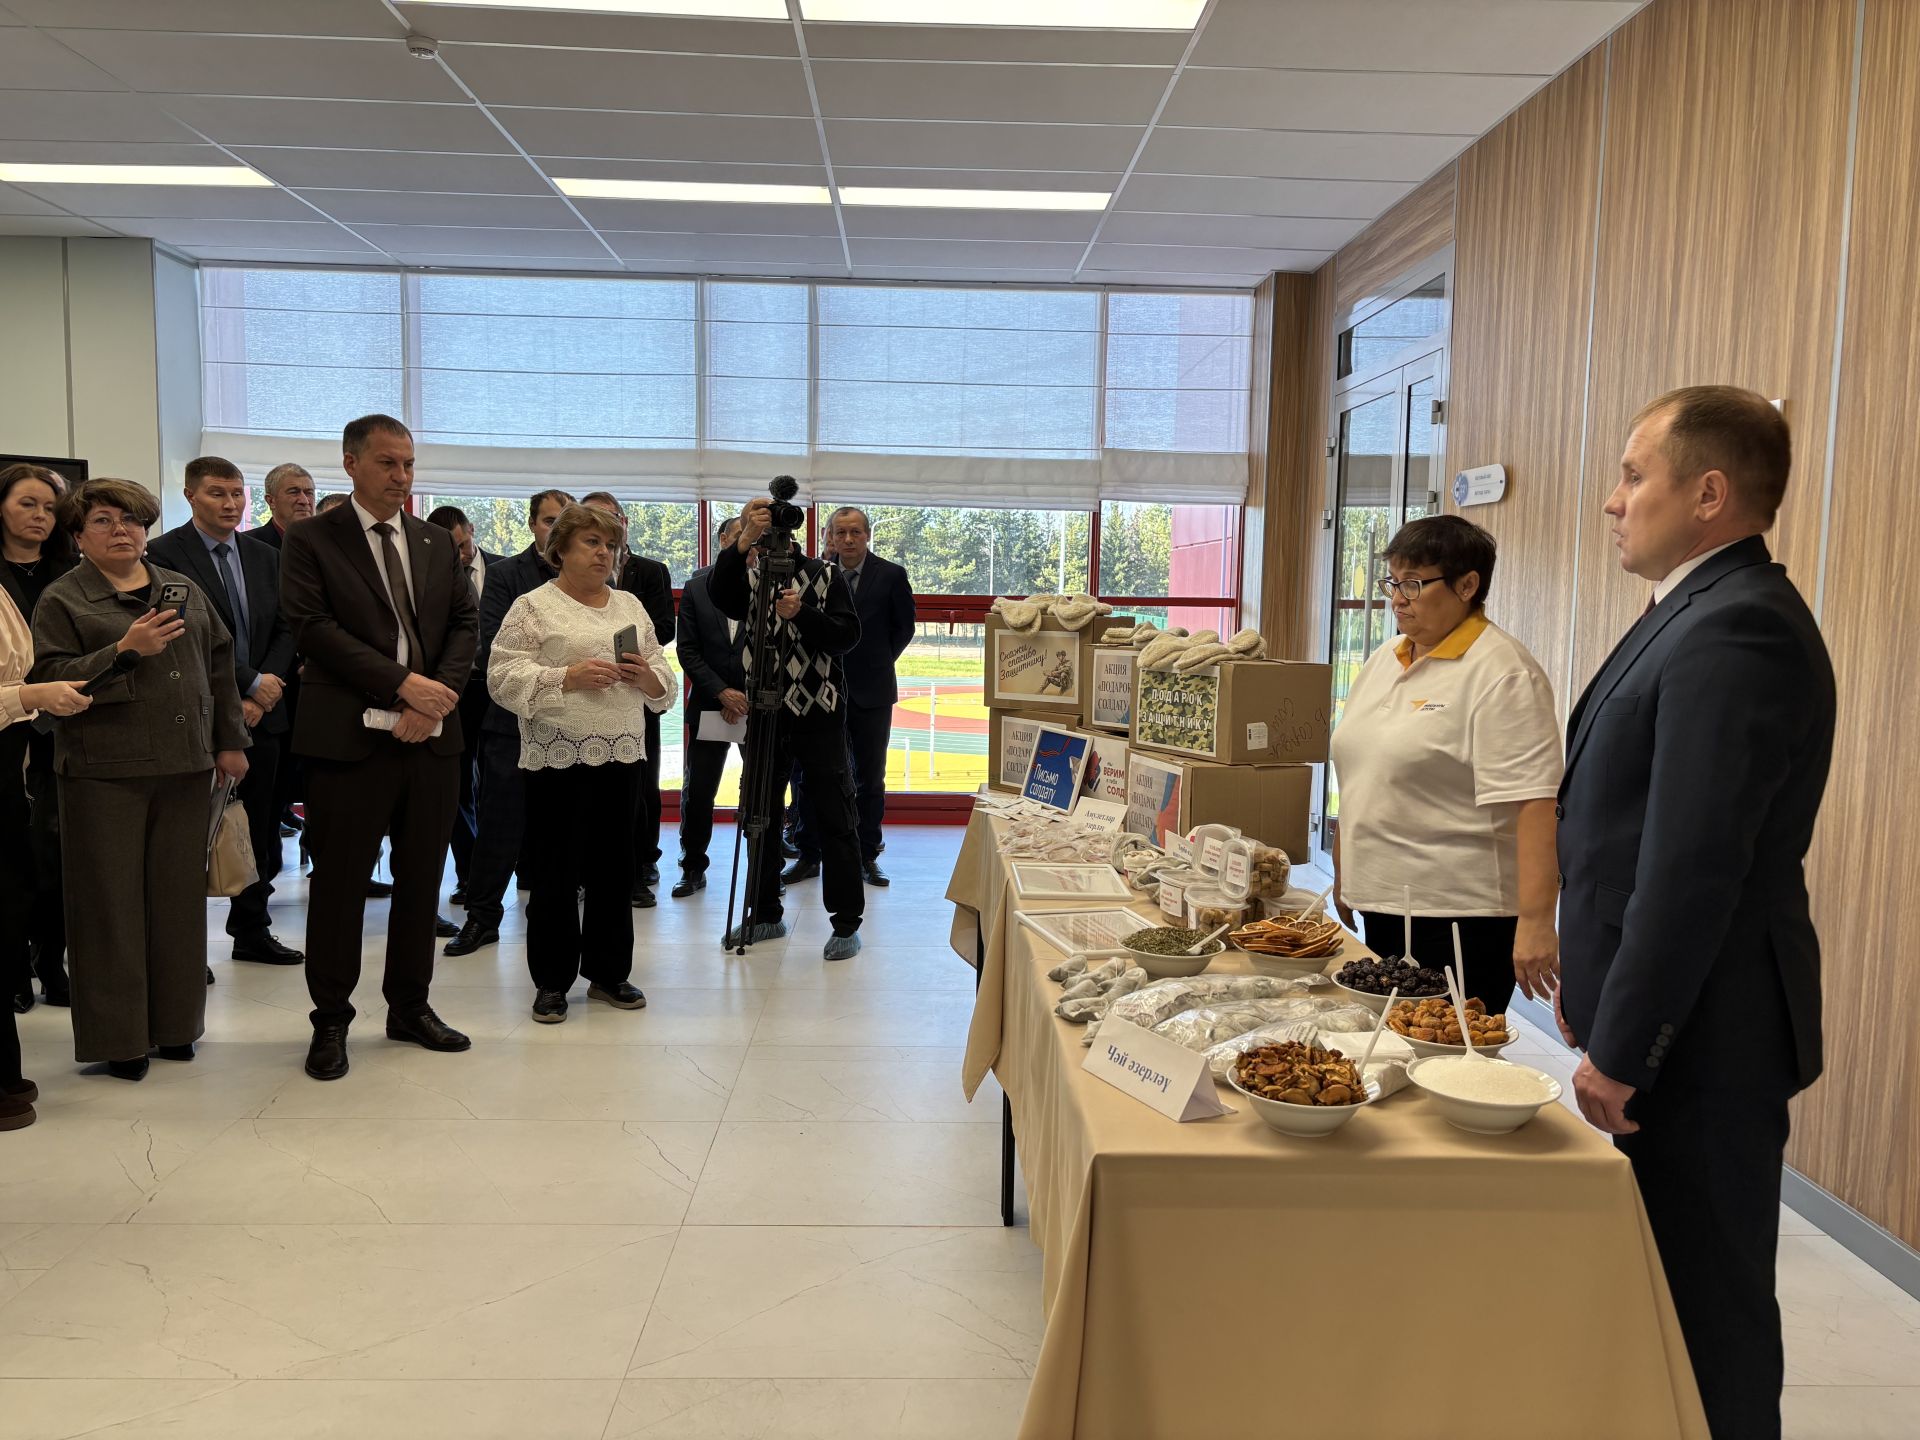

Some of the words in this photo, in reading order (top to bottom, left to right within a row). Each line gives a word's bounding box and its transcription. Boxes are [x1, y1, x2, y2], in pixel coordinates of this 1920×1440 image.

[1000, 643, 1028, 662] Скажи
[1007, 645, 1037, 667] спасибо
[1000, 649, 1048, 680] Защитнику!
[1103, 663, 1127, 676] АКЦИЯ
[1151, 688, 1203, 706] ПОДАРОК
[1142, 711, 1210, 731] ЗАЩИТНИКУ
[1012, 730, 1033, 743] АКЦИЯ
[1033, 763, 1059, 786] Письмо
[1103, 766, 1125, 780] ВЕРИМ
[1029, 782, 1057, 805] солдату
[1107, 1044, 1129, 1067] Чәй
[1127, 1058, 1173, 1094] әзерләү
